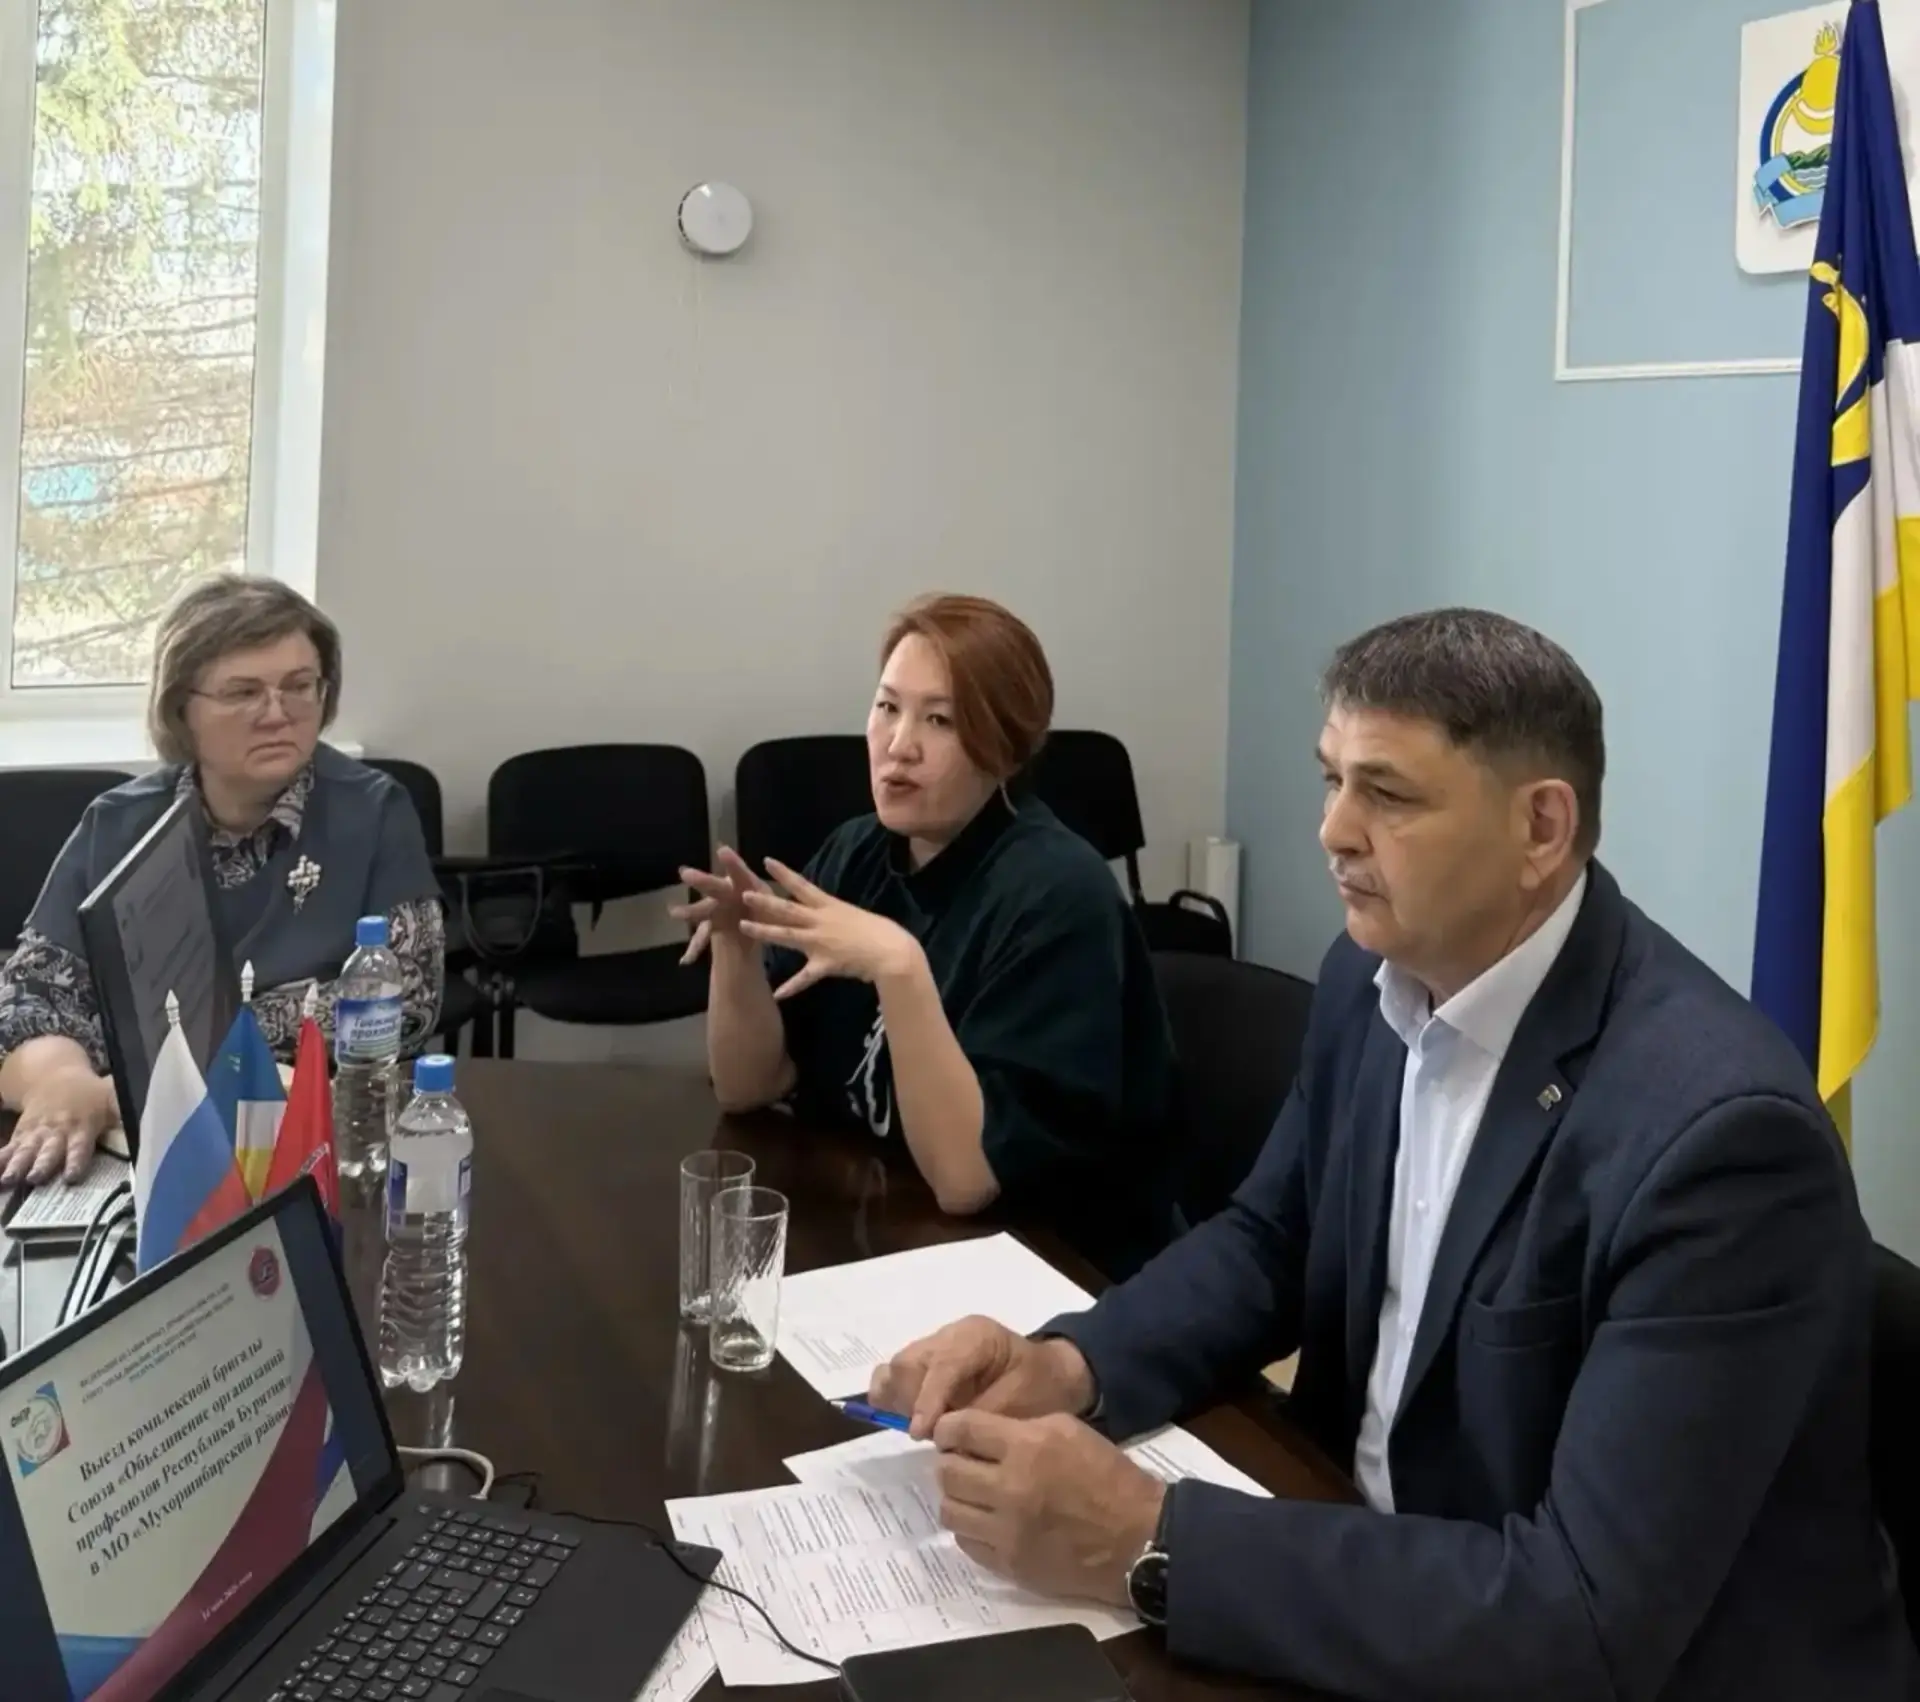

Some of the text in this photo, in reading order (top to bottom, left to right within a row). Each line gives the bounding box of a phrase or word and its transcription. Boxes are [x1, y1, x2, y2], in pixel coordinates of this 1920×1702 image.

[67, 1480, 115, 1524] Союза
[118, 1407, 209, 1486] «Объединение
[212, 1348, 285, 1413] организаций
[80, 1441, 127, 1482] Выезд
[127, 1373, 211, 1446] комплексной
[212, 1337, 263, 1383] бригады
[76, 1477, 161, 1553] профсоюзов
[162, 1416, 236, 1484] Республики
[89, 1559, 101, 1577] в
[100, 1529, 131, 1567] МО
